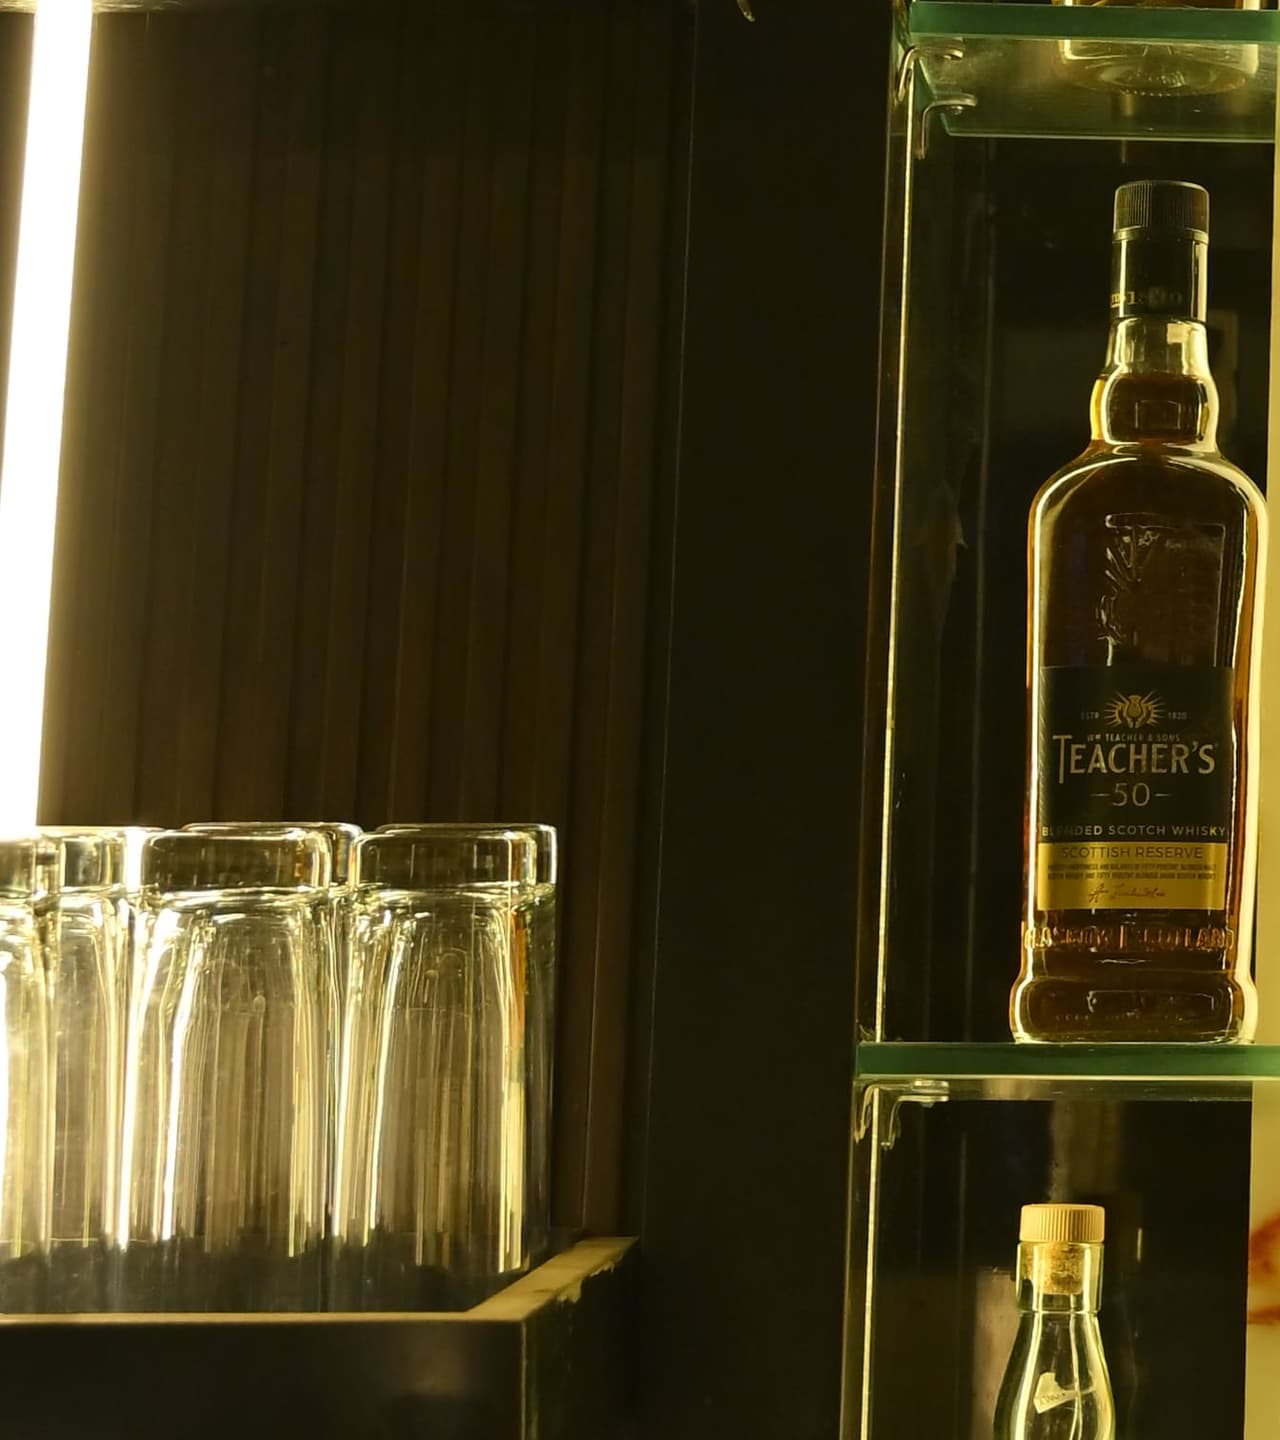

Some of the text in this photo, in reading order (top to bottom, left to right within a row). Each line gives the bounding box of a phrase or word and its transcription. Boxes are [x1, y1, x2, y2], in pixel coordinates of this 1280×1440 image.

[1051, 734, 1217, 785] TEACHER'S
[1111, 782, 1152, 808] 50
[1108, 824, 1226, 838] SCOTCH WHISKY
[1062, 846, 1205, 860] SCOTTISH RESERVE
